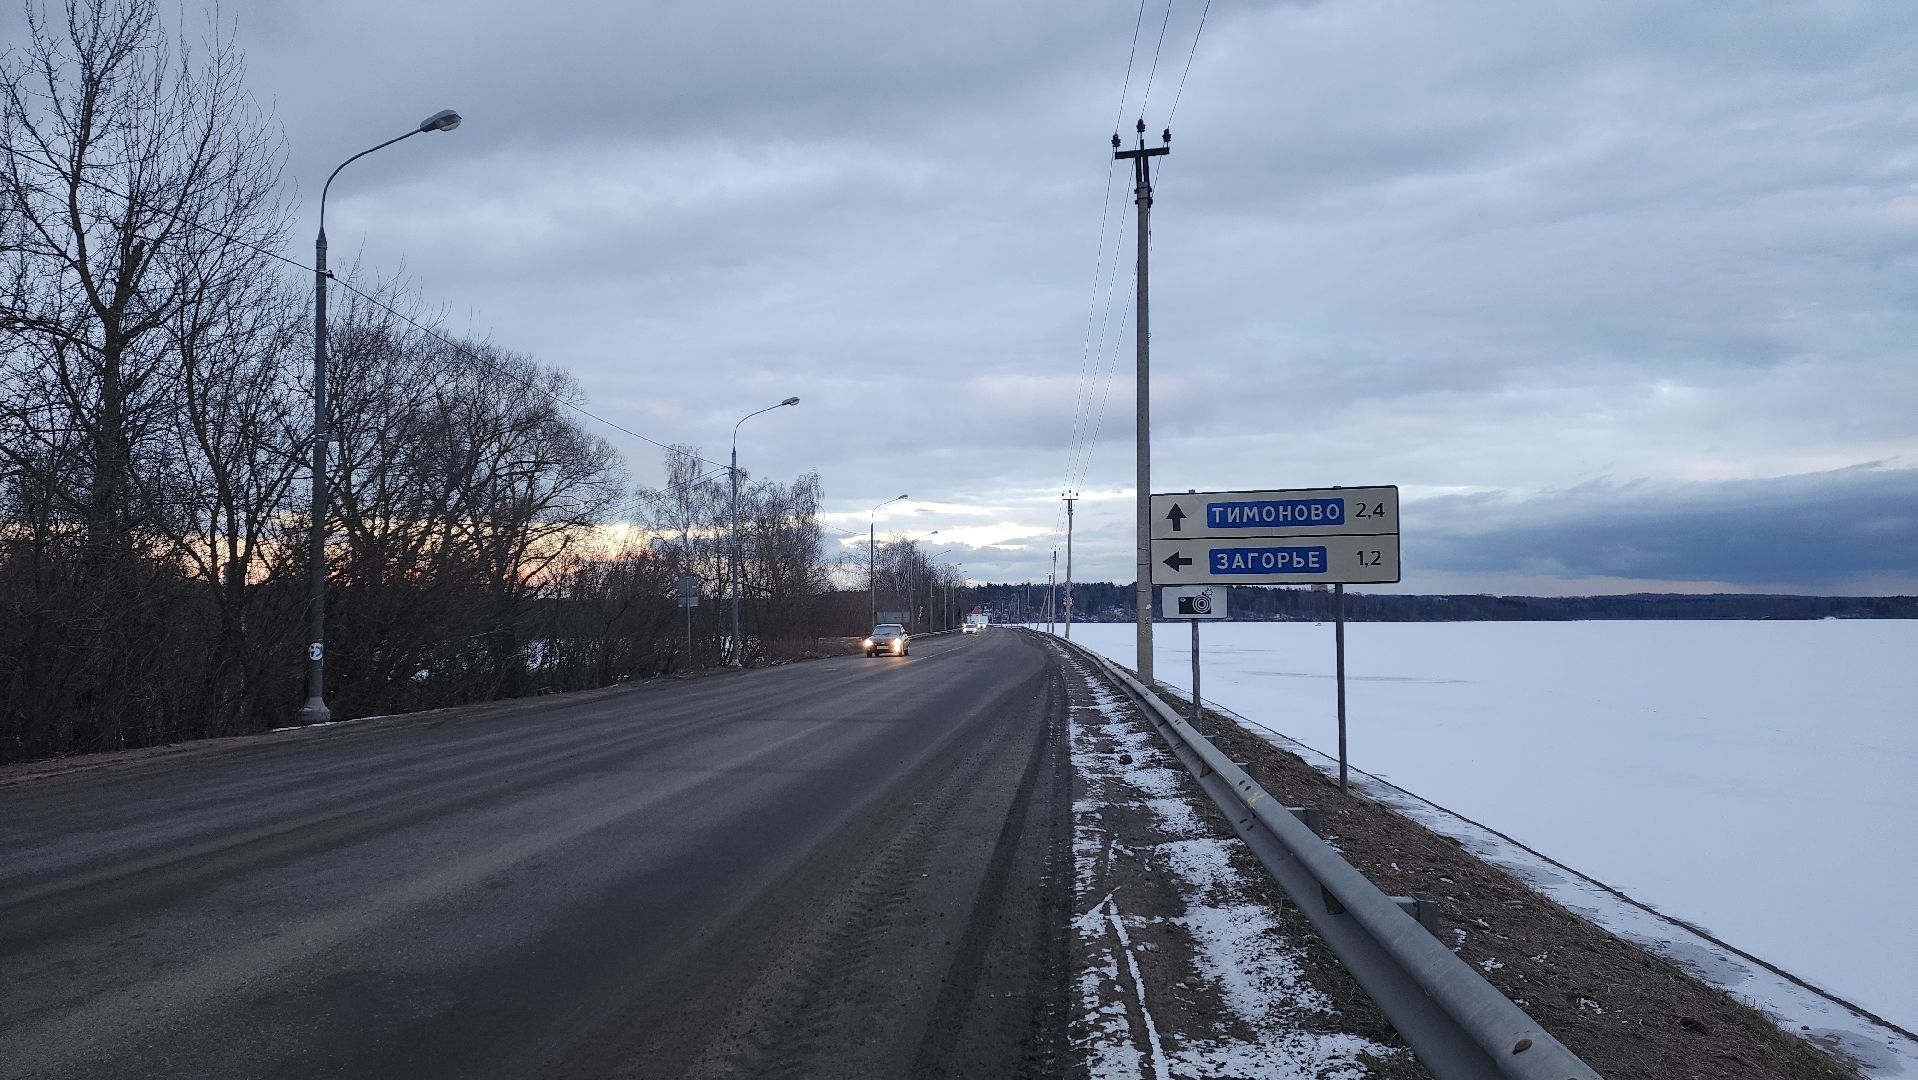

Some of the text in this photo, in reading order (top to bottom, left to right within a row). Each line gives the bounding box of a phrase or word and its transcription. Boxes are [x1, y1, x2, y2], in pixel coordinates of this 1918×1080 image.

[1211, 502, 1385, 523] ТИМОНОВО 2,4
[1216, 550, 1382, 570] ЗАГОРЬЕ 1,2
